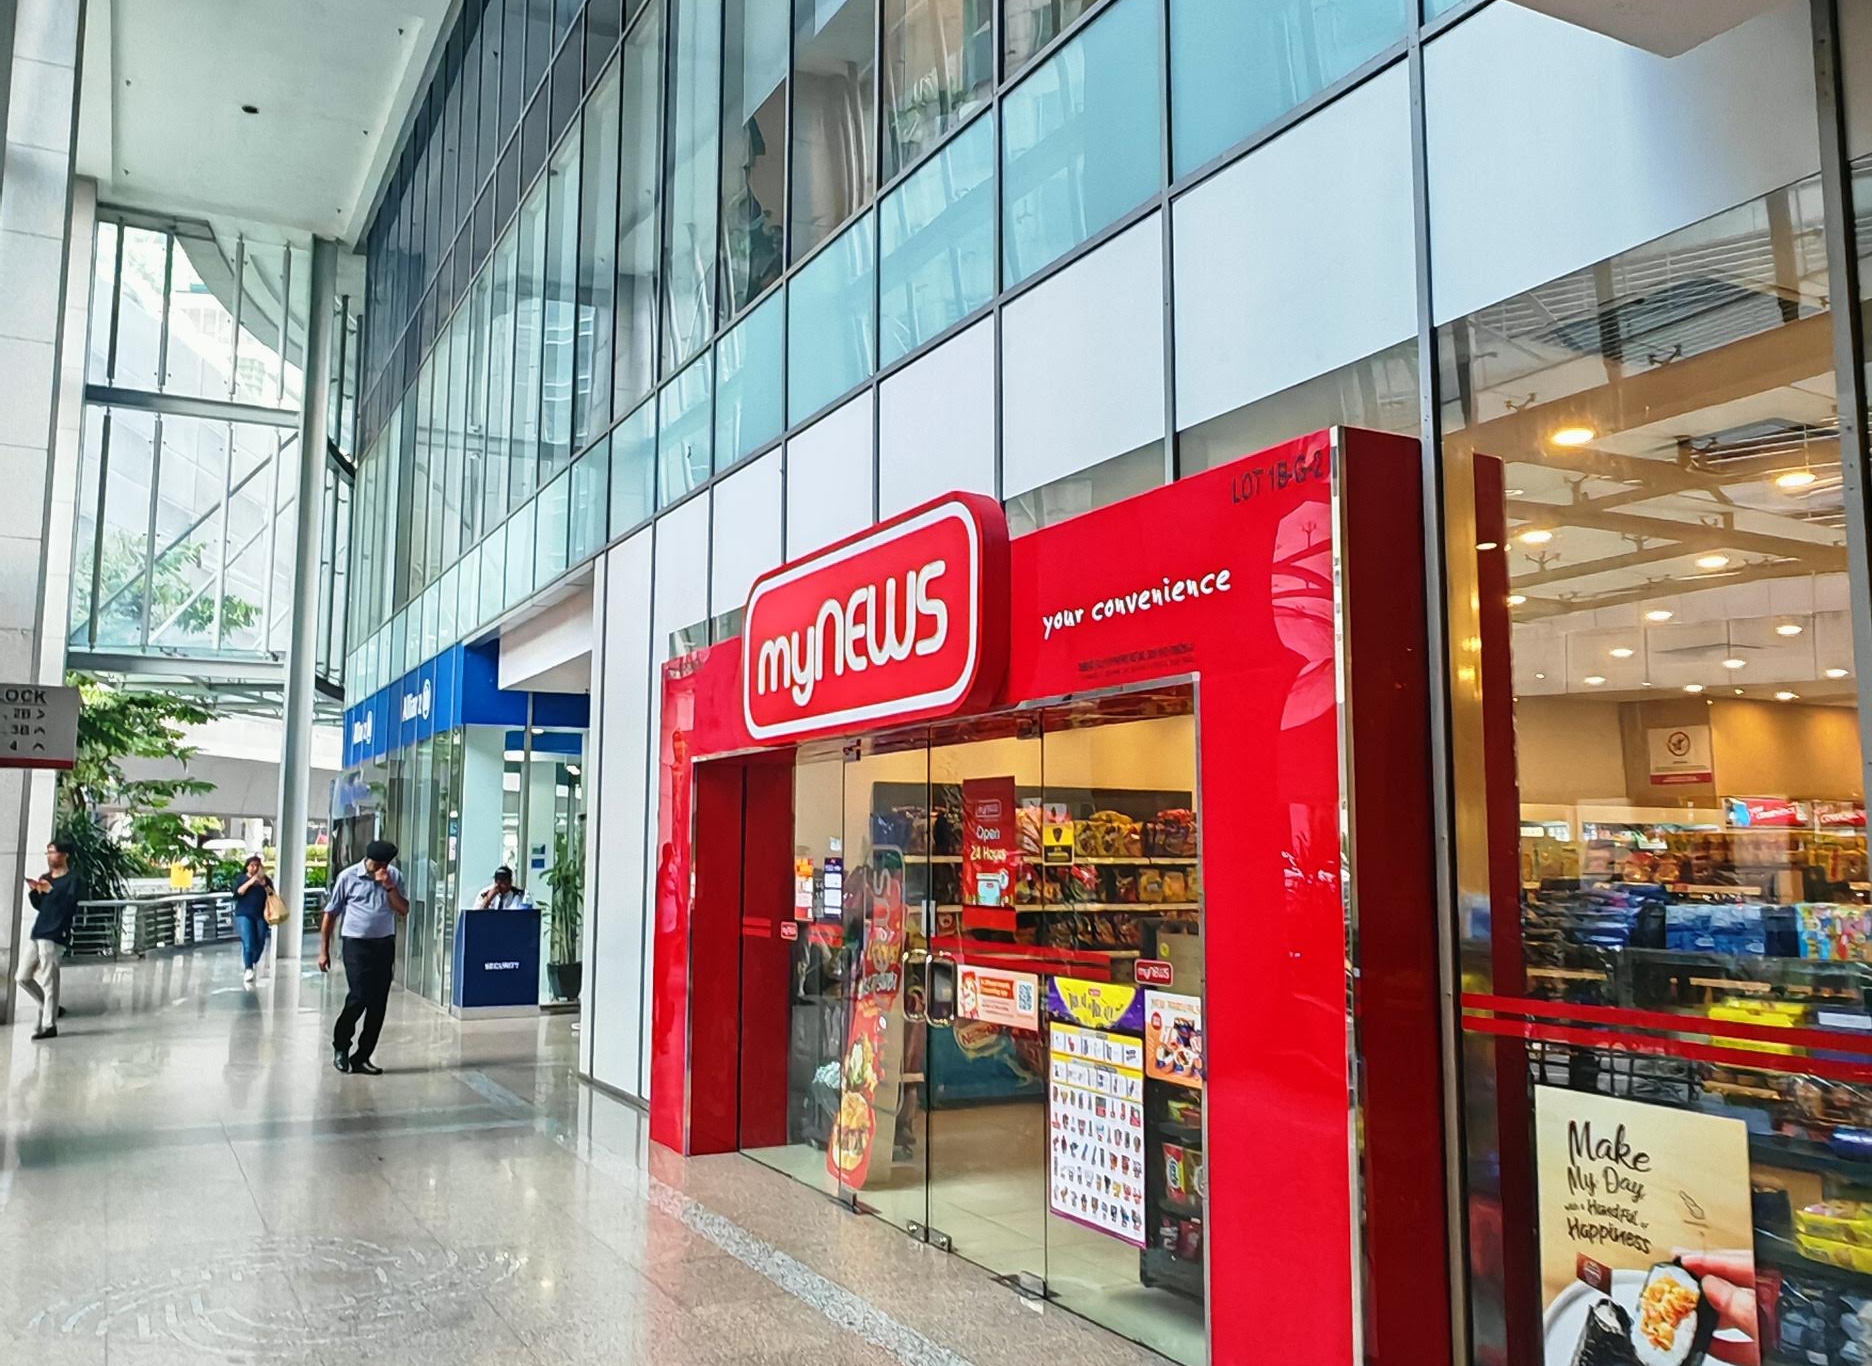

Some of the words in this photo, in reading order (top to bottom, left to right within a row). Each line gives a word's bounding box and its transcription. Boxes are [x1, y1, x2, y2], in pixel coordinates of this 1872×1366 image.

[1232, 467, 1264, 504] LOT
[1042, 607, 1084, 641] your
[1091, 569, 1231, 621] convenience
[0, 688, 47, 705] OCK
[976, 825, 1001, 842] Open
[970, 845, 981, 861] 24
[1567, 1120, 1652, 1172] Make
[1567, 1165, 1598, 1197] My
[1603, 1166, 1646, 1203] Day
[1566, 1216, 1652, 1255] Happiness
